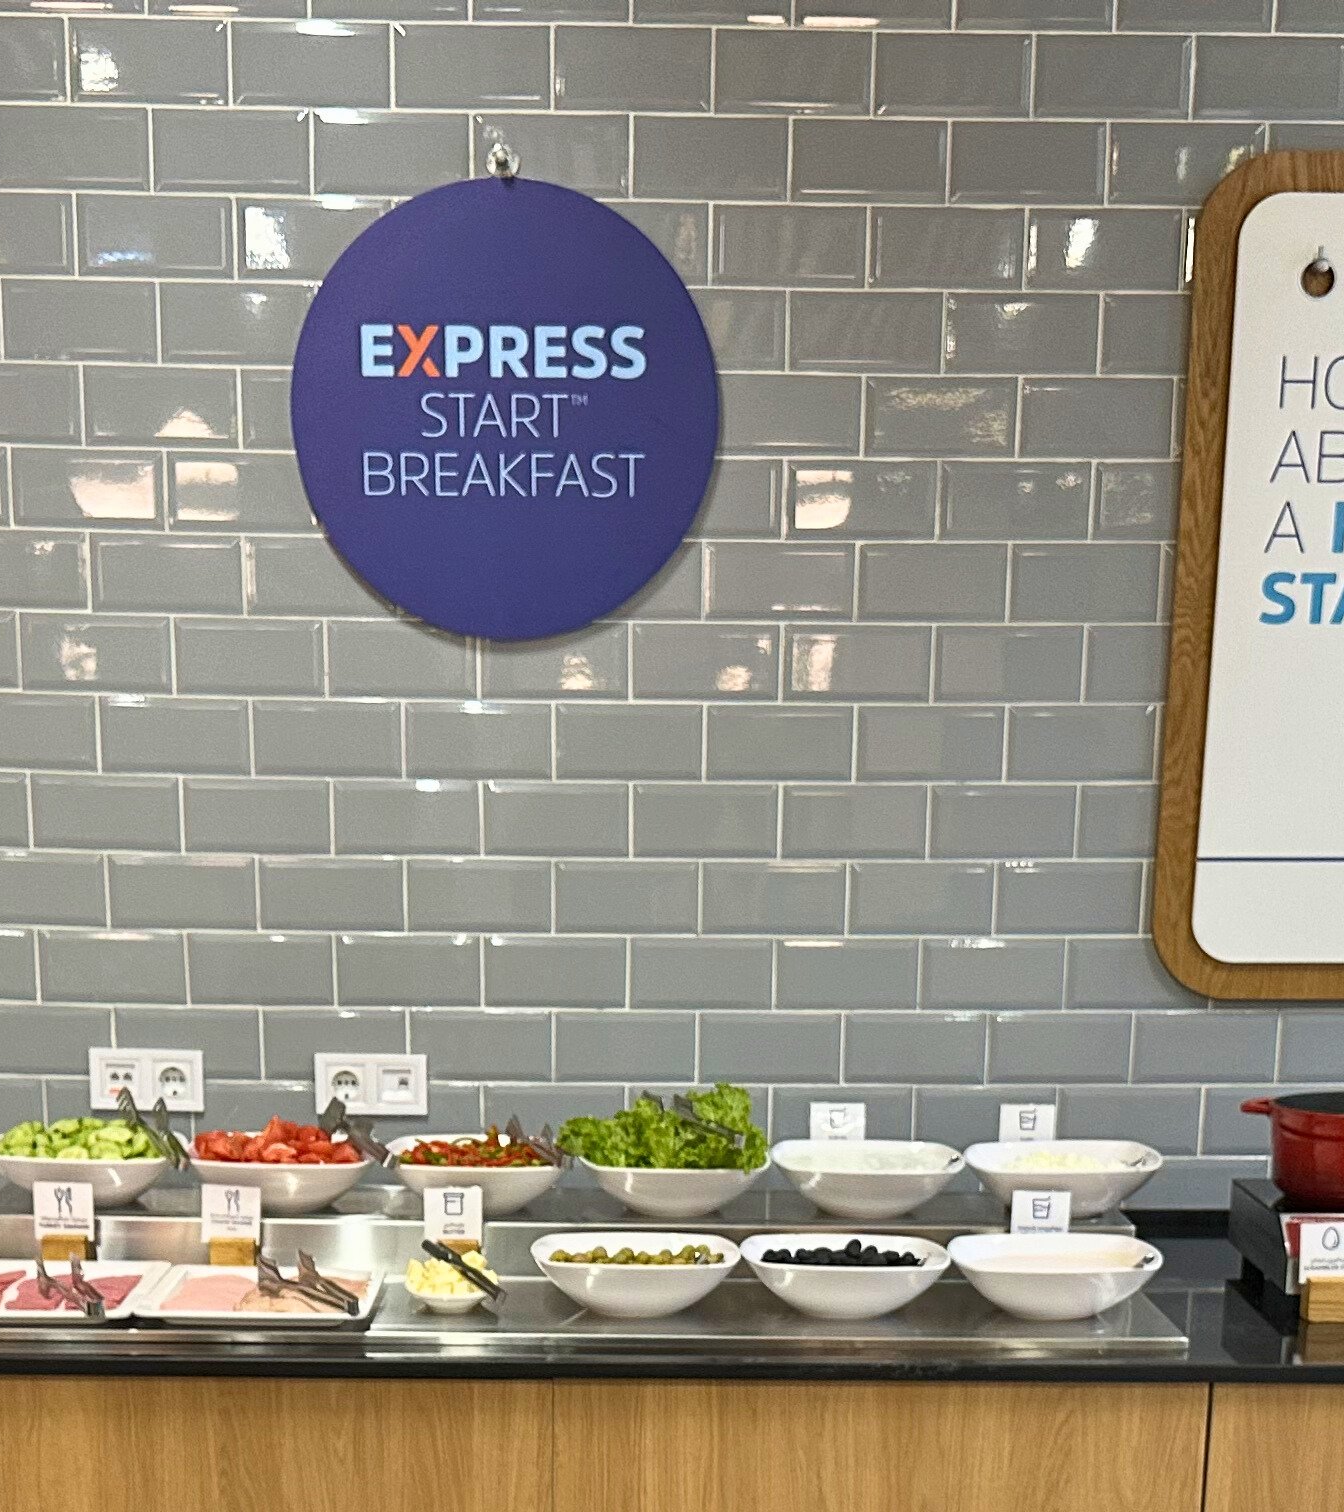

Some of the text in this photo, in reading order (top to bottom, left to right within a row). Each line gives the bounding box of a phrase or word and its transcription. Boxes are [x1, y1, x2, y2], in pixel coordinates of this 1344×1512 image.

[360, 324, 647, 379] EXPRESS
[363, 451, 646, 498] BREAKFAST
[1263, 501, 1305, 553] A
